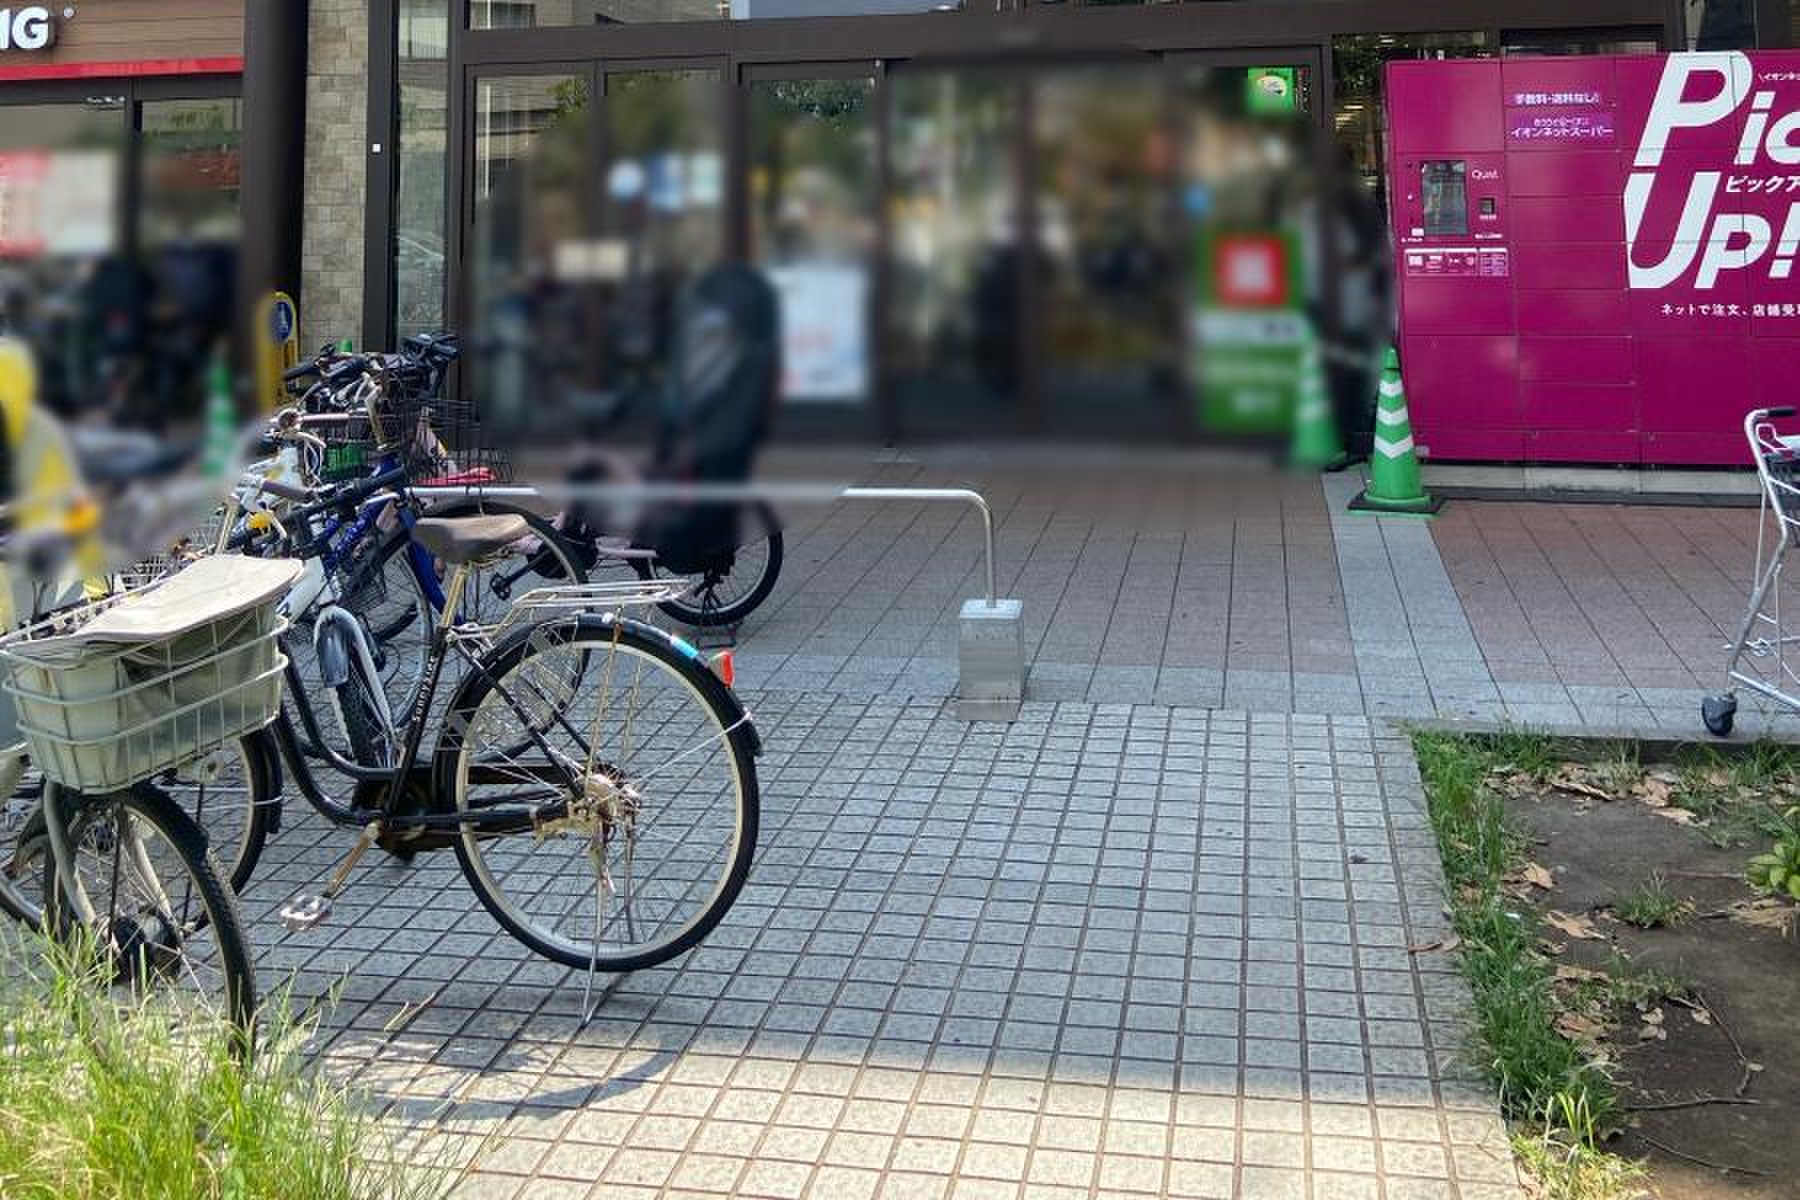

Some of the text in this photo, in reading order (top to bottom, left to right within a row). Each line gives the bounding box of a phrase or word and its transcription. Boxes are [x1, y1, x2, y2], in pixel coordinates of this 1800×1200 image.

[1660, 303, 1800, 317] ネットで注文、店舗受
